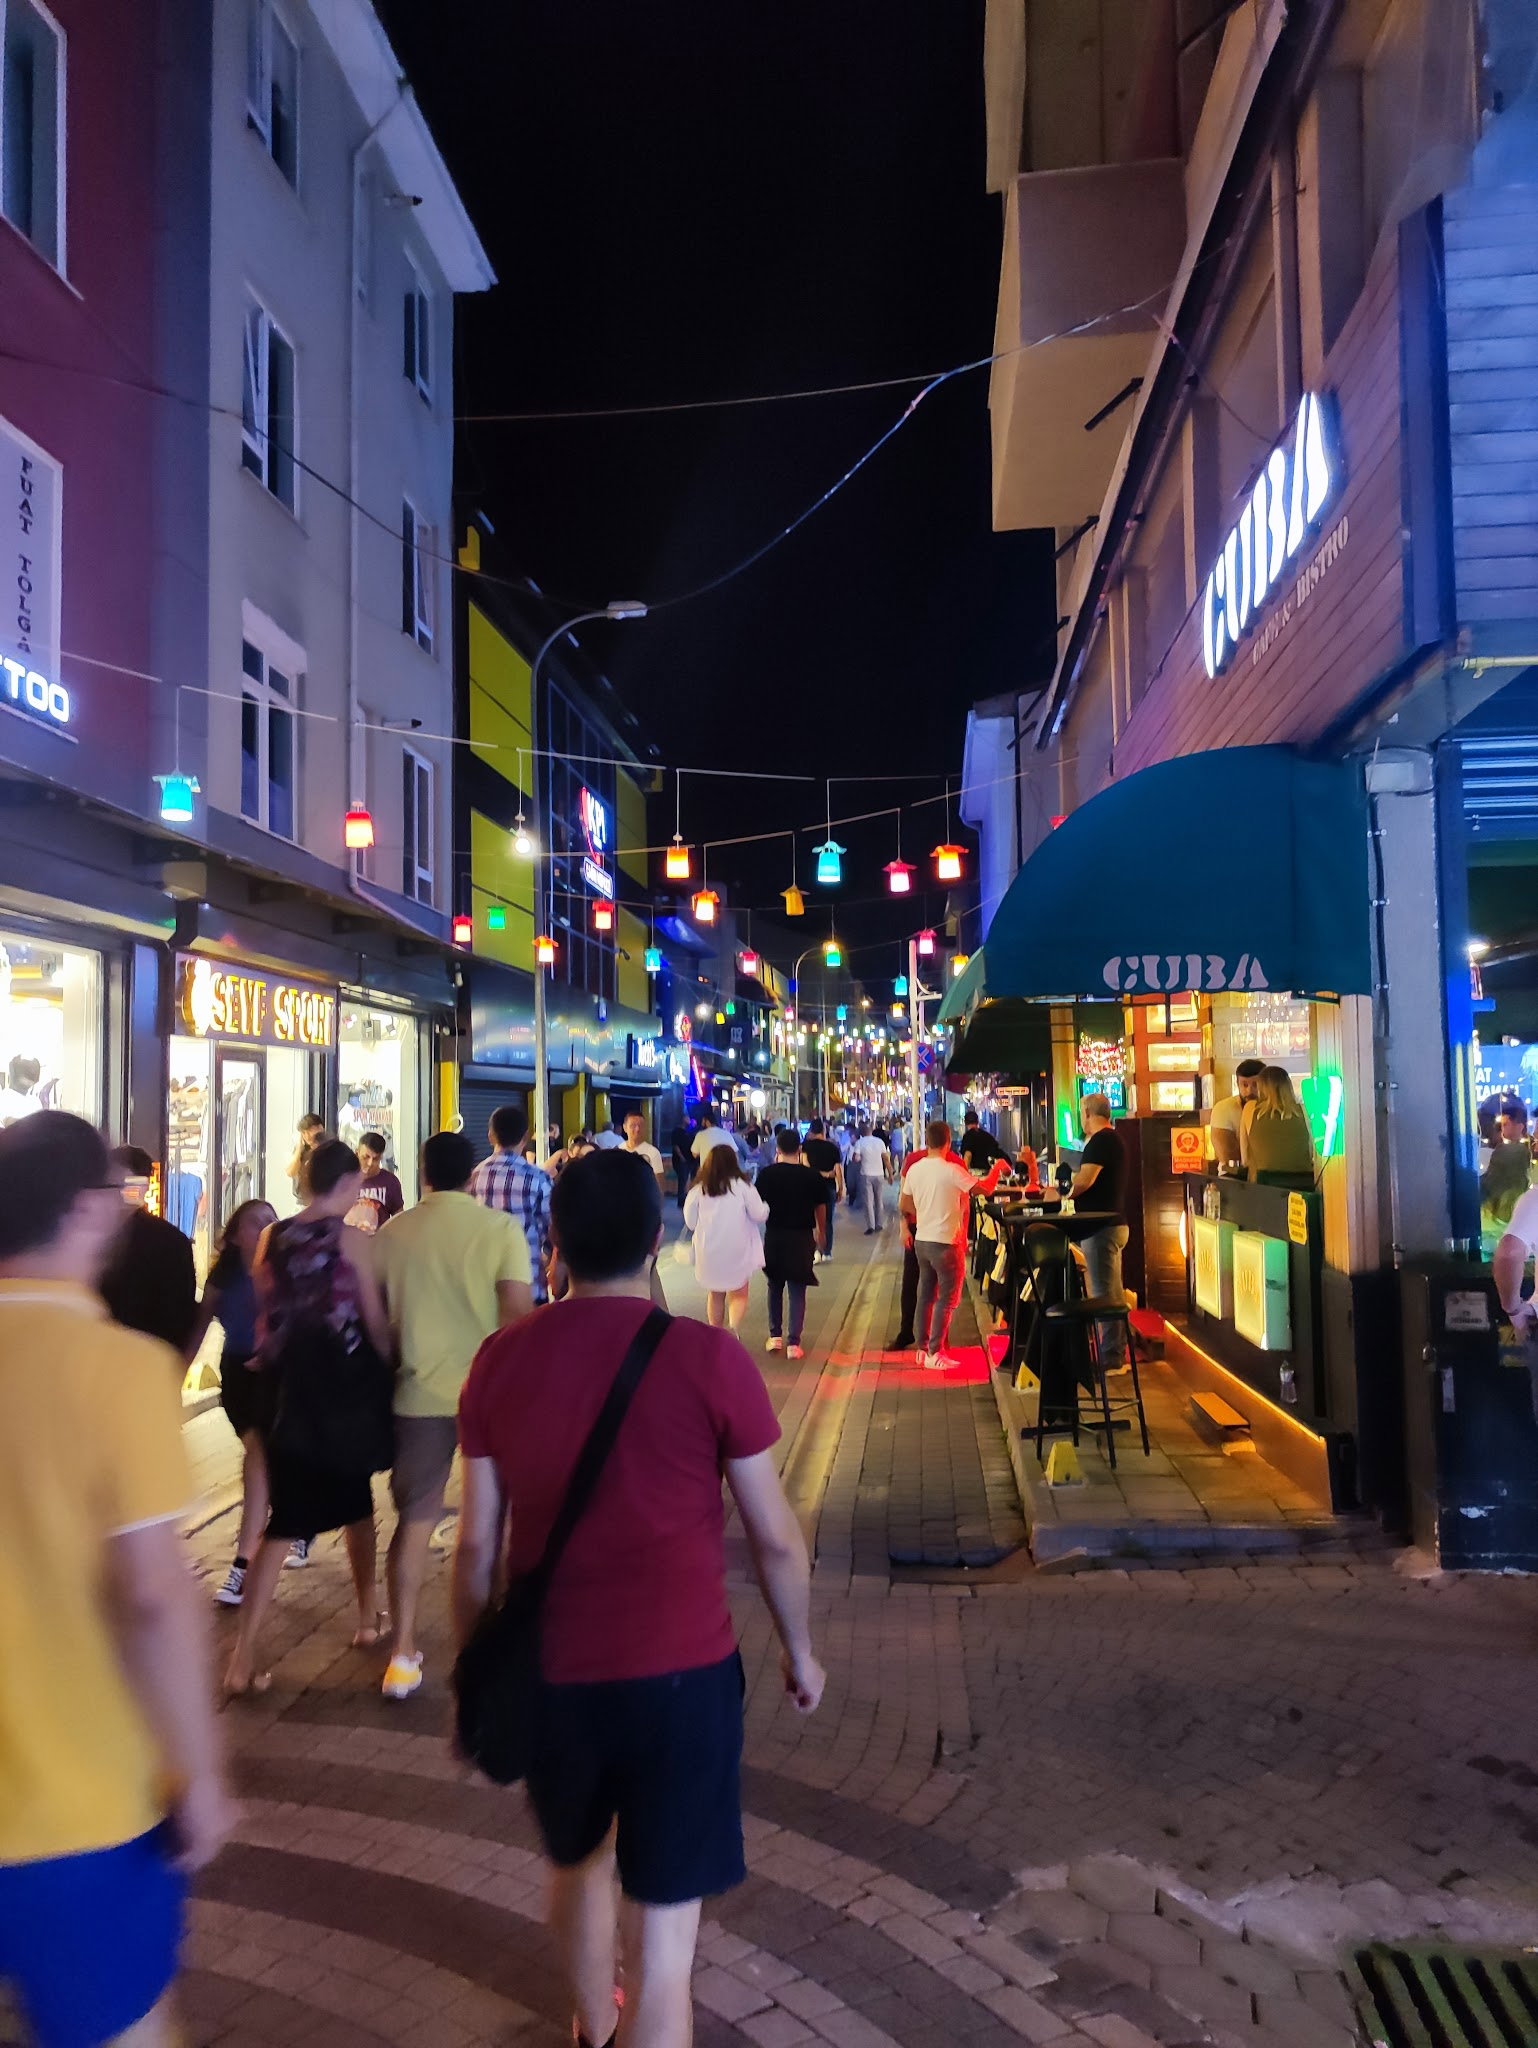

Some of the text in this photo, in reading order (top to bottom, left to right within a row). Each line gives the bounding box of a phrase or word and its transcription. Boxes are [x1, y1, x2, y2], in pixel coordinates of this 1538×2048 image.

[17, 456, 33, 654] FUAT TOLGA
[1203, 391, 1329, 680] CUBA
[1296, 515, 1349, 609] BISTRO
[0, 653, 70, 723] TOO
[1103, 953, 1269, 990] CUBA
[273, 985, 334, 1046] SPORT
